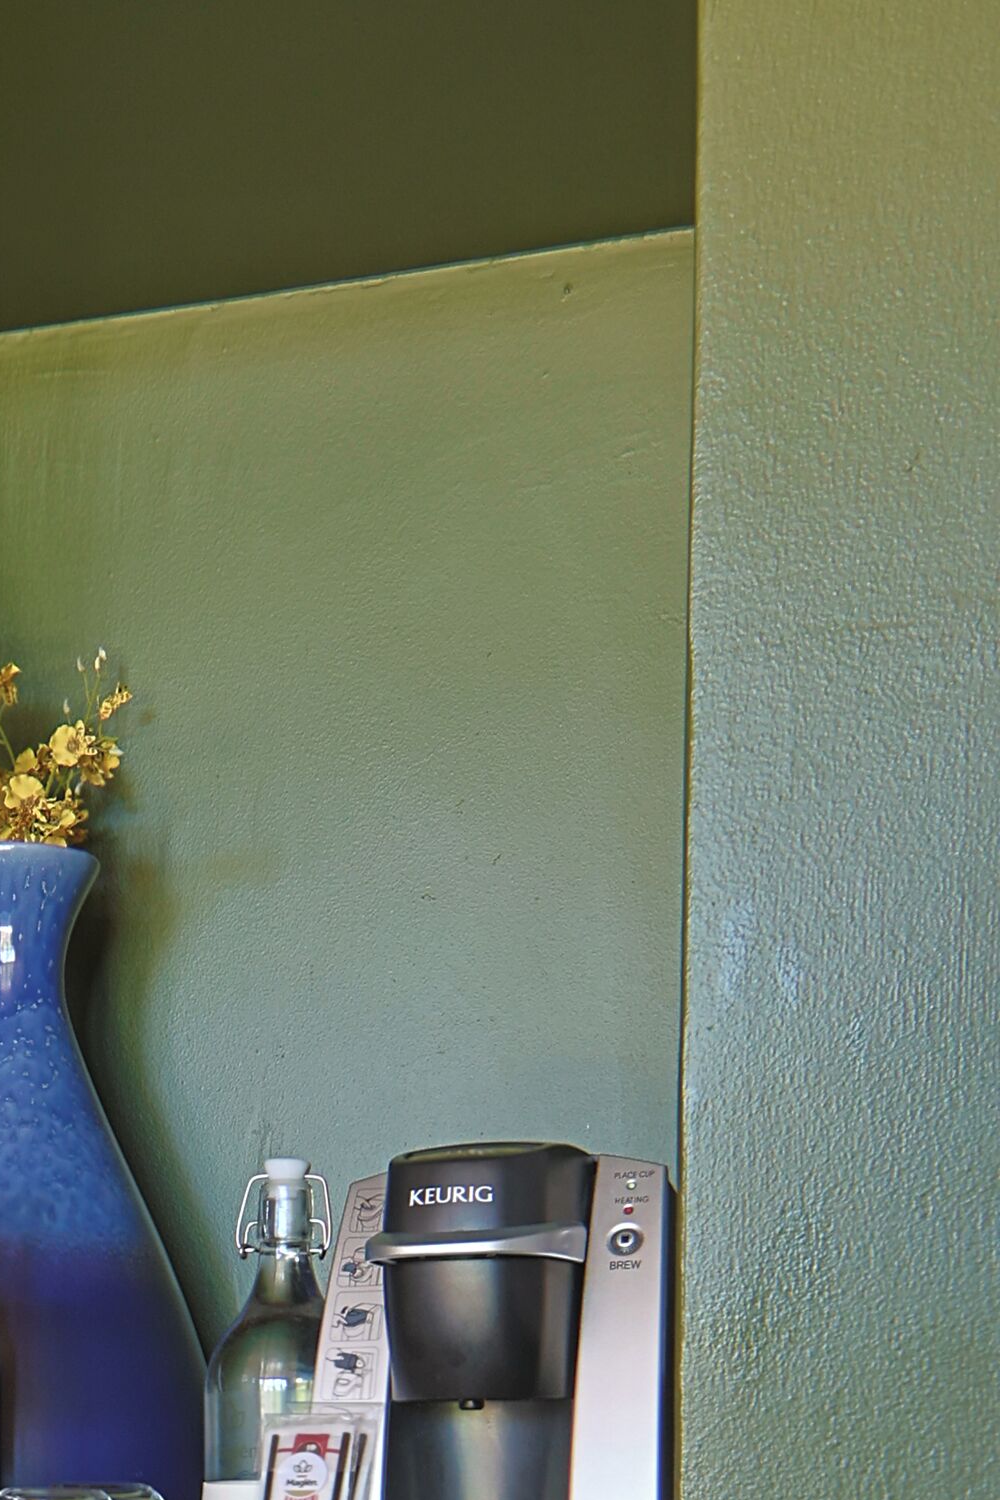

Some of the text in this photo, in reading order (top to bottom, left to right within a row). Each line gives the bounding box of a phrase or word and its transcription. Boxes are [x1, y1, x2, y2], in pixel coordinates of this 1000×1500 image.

[614, 1171, 637, 1179] PLACE
[409, 1186, 494, 1206] KEURIG
[614, 1196, 649, 1204] HEATING
[609, 1260, 642, 1271] BREW
